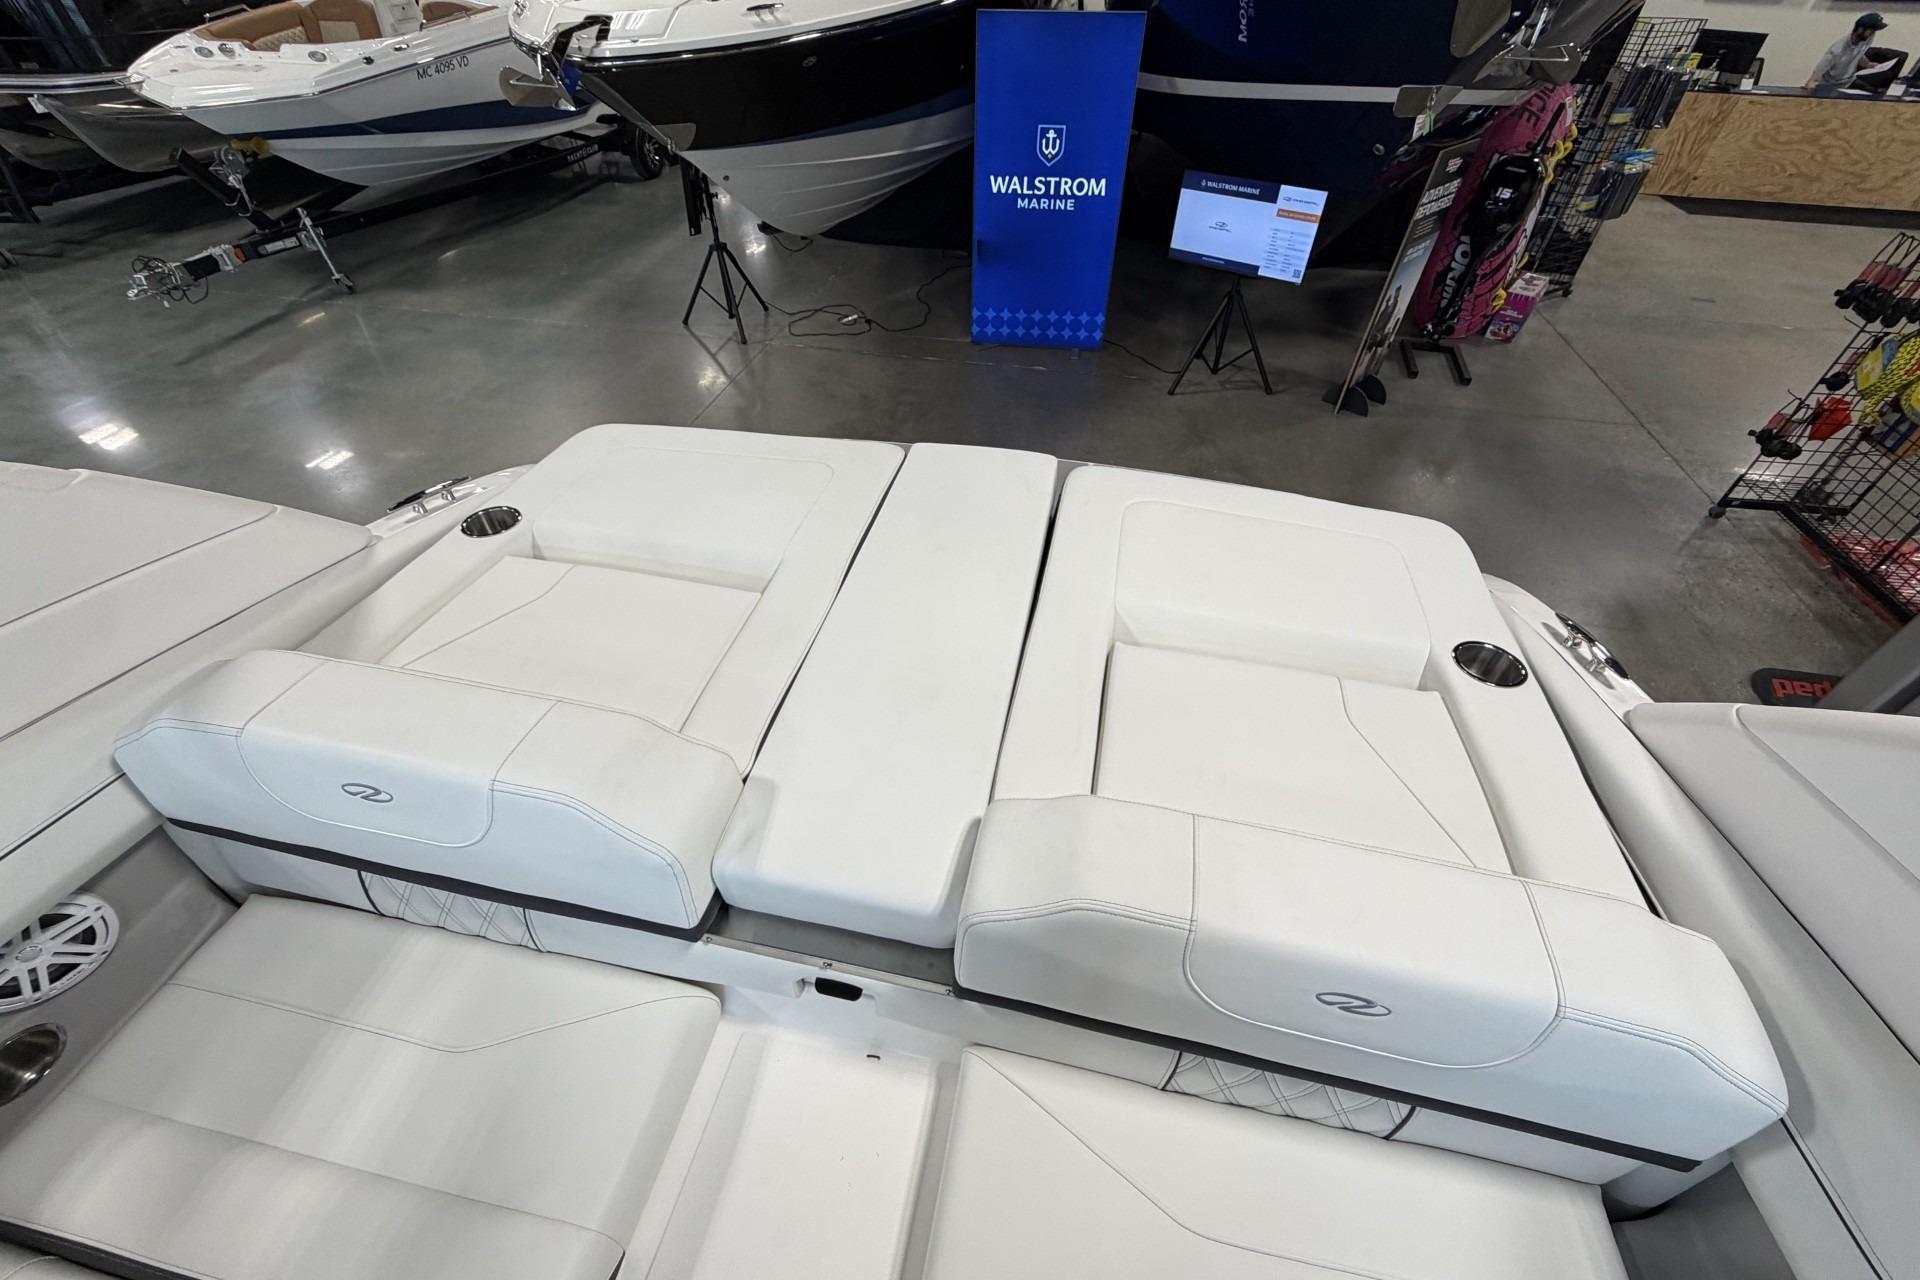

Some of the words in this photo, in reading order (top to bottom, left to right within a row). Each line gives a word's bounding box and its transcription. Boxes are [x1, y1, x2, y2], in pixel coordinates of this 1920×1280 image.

[416, 65, 433, 81] MC
[434, 59, 456, 75] 4095
[455, 55, 470, 69] VD
[989, 175, 1107, 197] WALSTROM
[1207, 180, 1239, 192] WALSTROM
[1238, 185, 1261, 195] MARINE
[1017, 197, 1076, 211] MARINE
